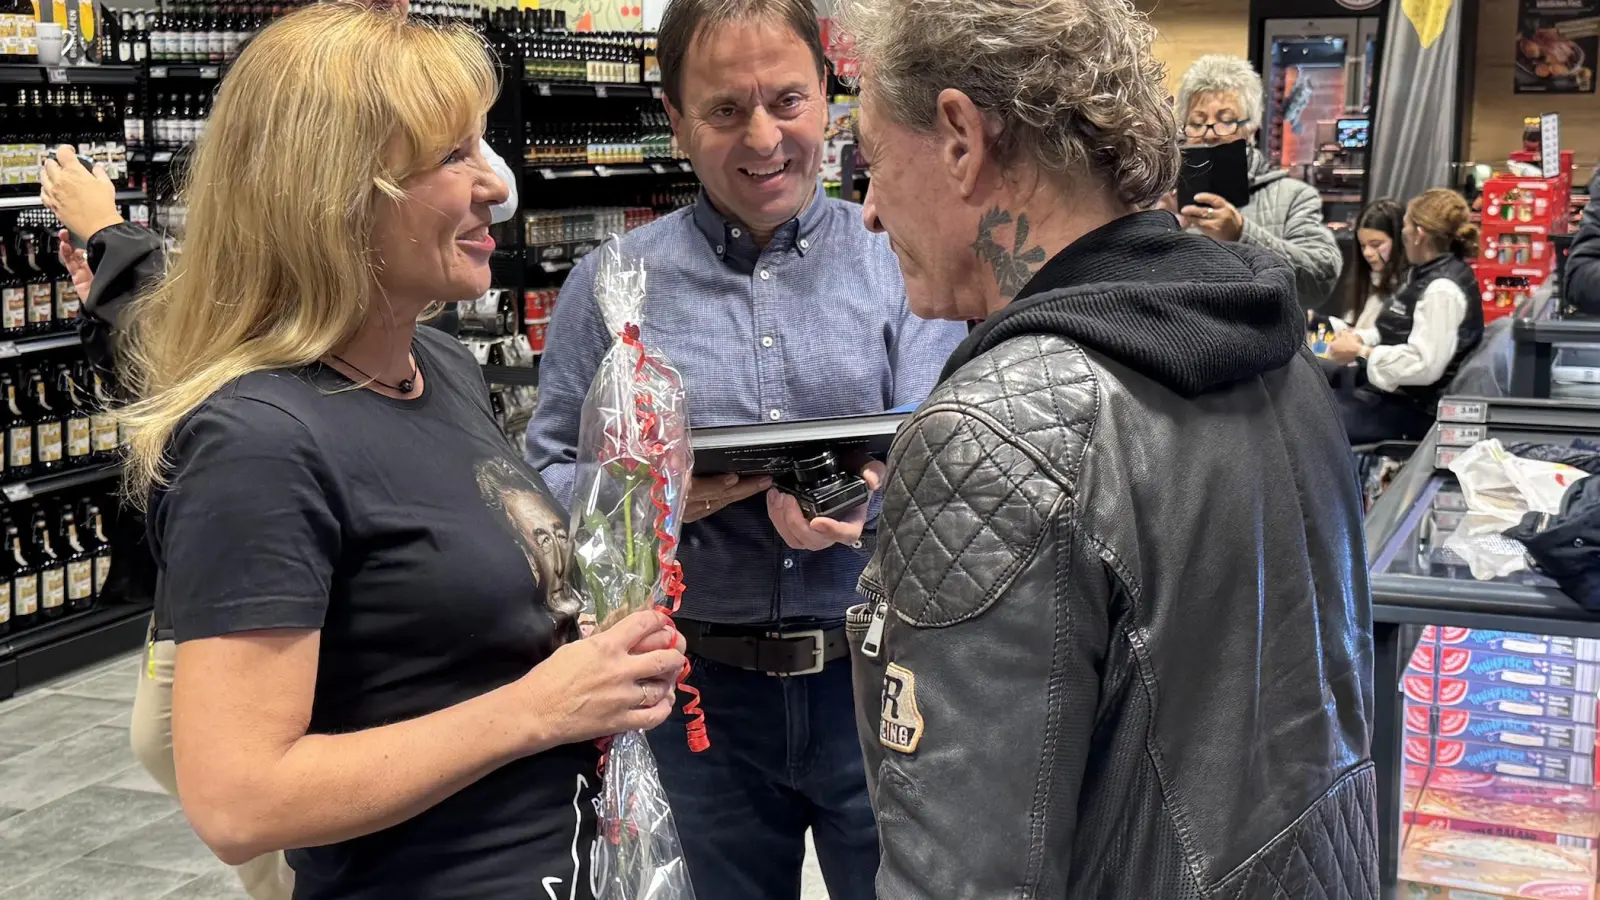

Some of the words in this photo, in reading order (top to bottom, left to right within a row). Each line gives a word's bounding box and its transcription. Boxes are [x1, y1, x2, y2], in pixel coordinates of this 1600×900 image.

[1470, 655, 1533, 675] THUNFISCH
[1467, 687, 1529, 706] THUNFISCH
[1468, 718, 1529, 737] THUNFISCH
[1465, 749, 1525, 767] THUNFISCH
